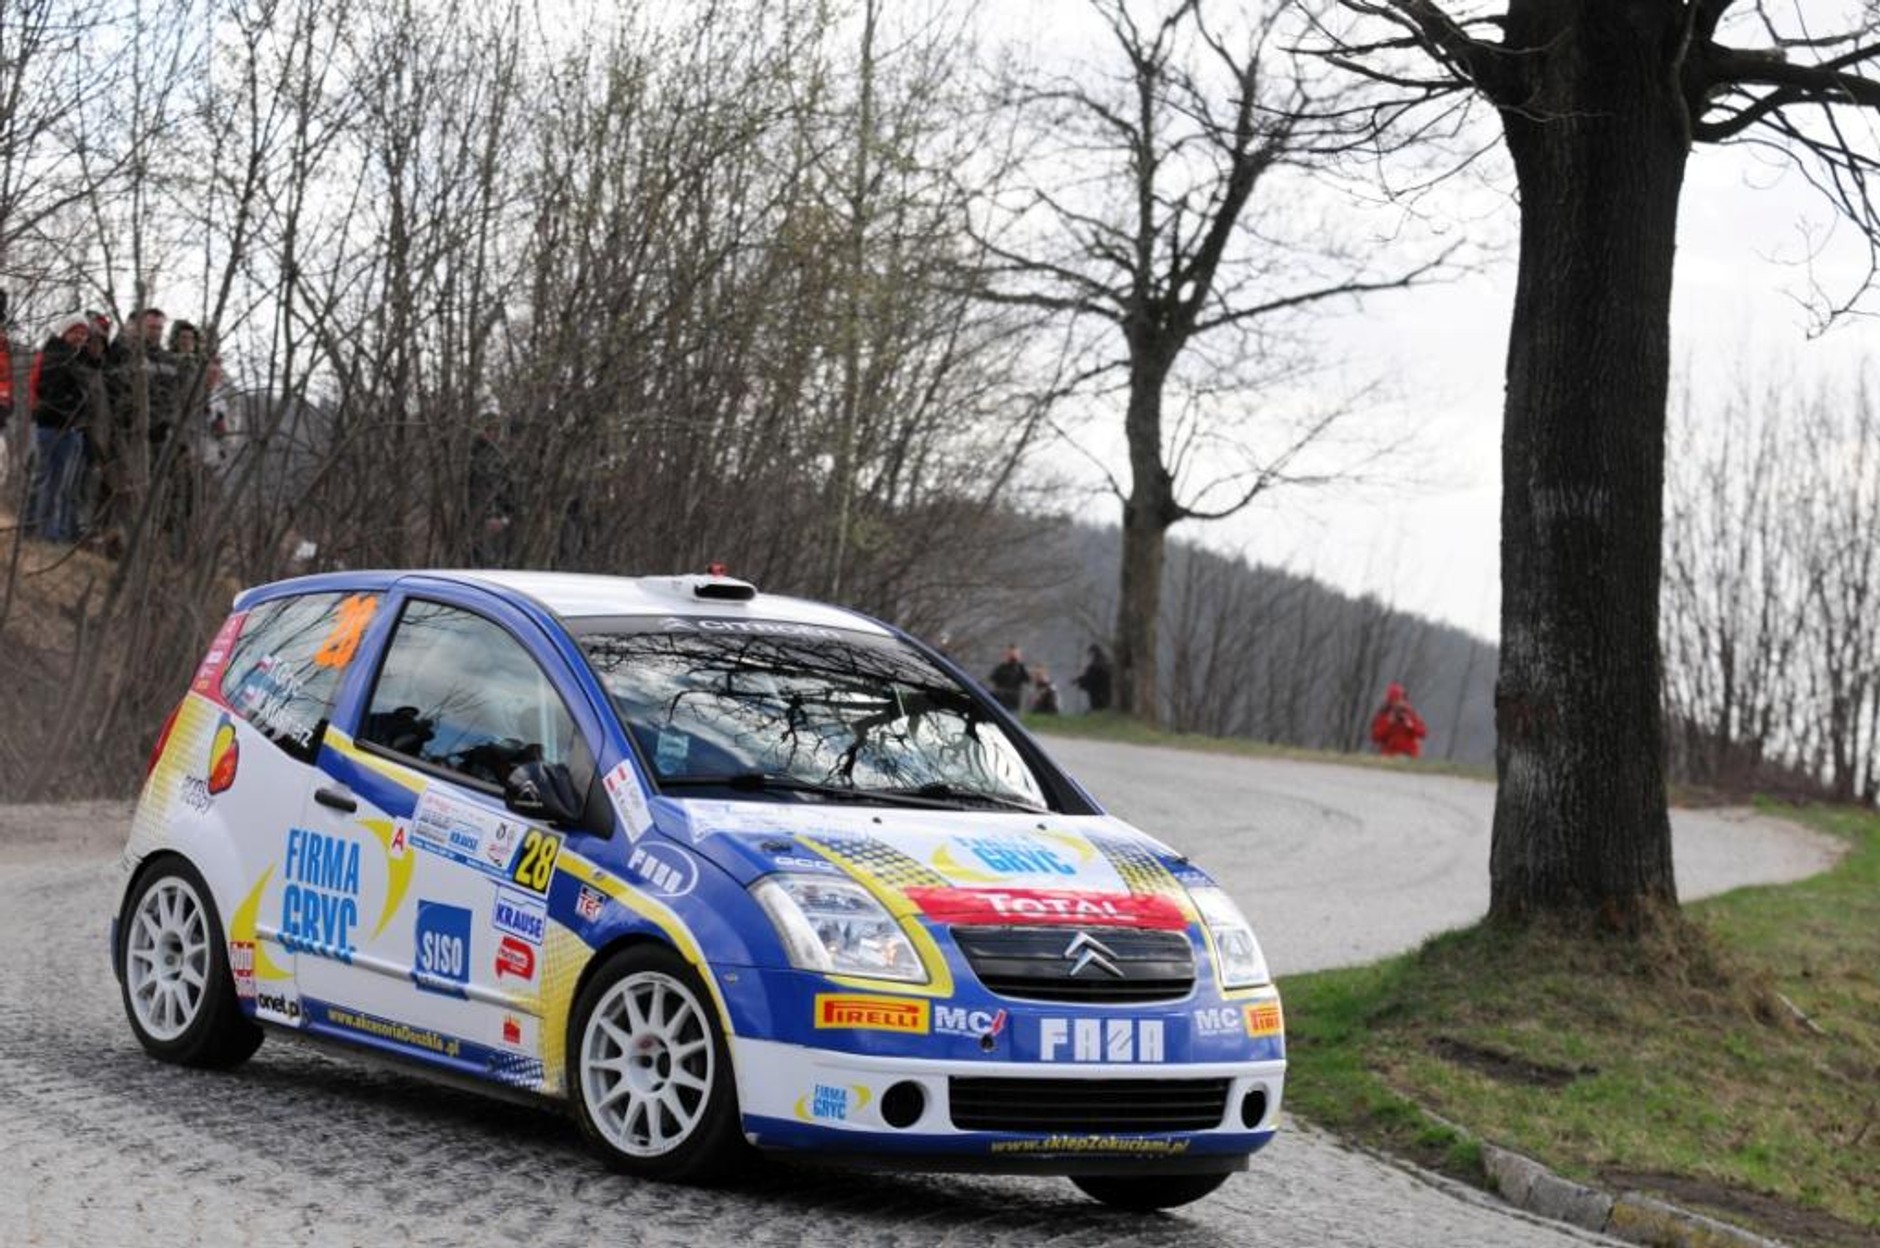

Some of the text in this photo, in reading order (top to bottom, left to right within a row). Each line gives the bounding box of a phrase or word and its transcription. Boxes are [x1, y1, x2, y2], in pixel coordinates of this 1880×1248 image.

[391, 826, 404, 851] A
[286, 828, 360, 894] FIRMA
[515, 829, 558, 890] 28
[971, 848, 1076, 874] GRYC
[496, 903, 542, 940] KRAUSE
[975, 892, 1137, 921] TOTAL
[423, 931, 462, 976] SISO
[823, 1000, 920, 1028] PIRELLI
[1040, 1018, 1165, 1062] FAZA
